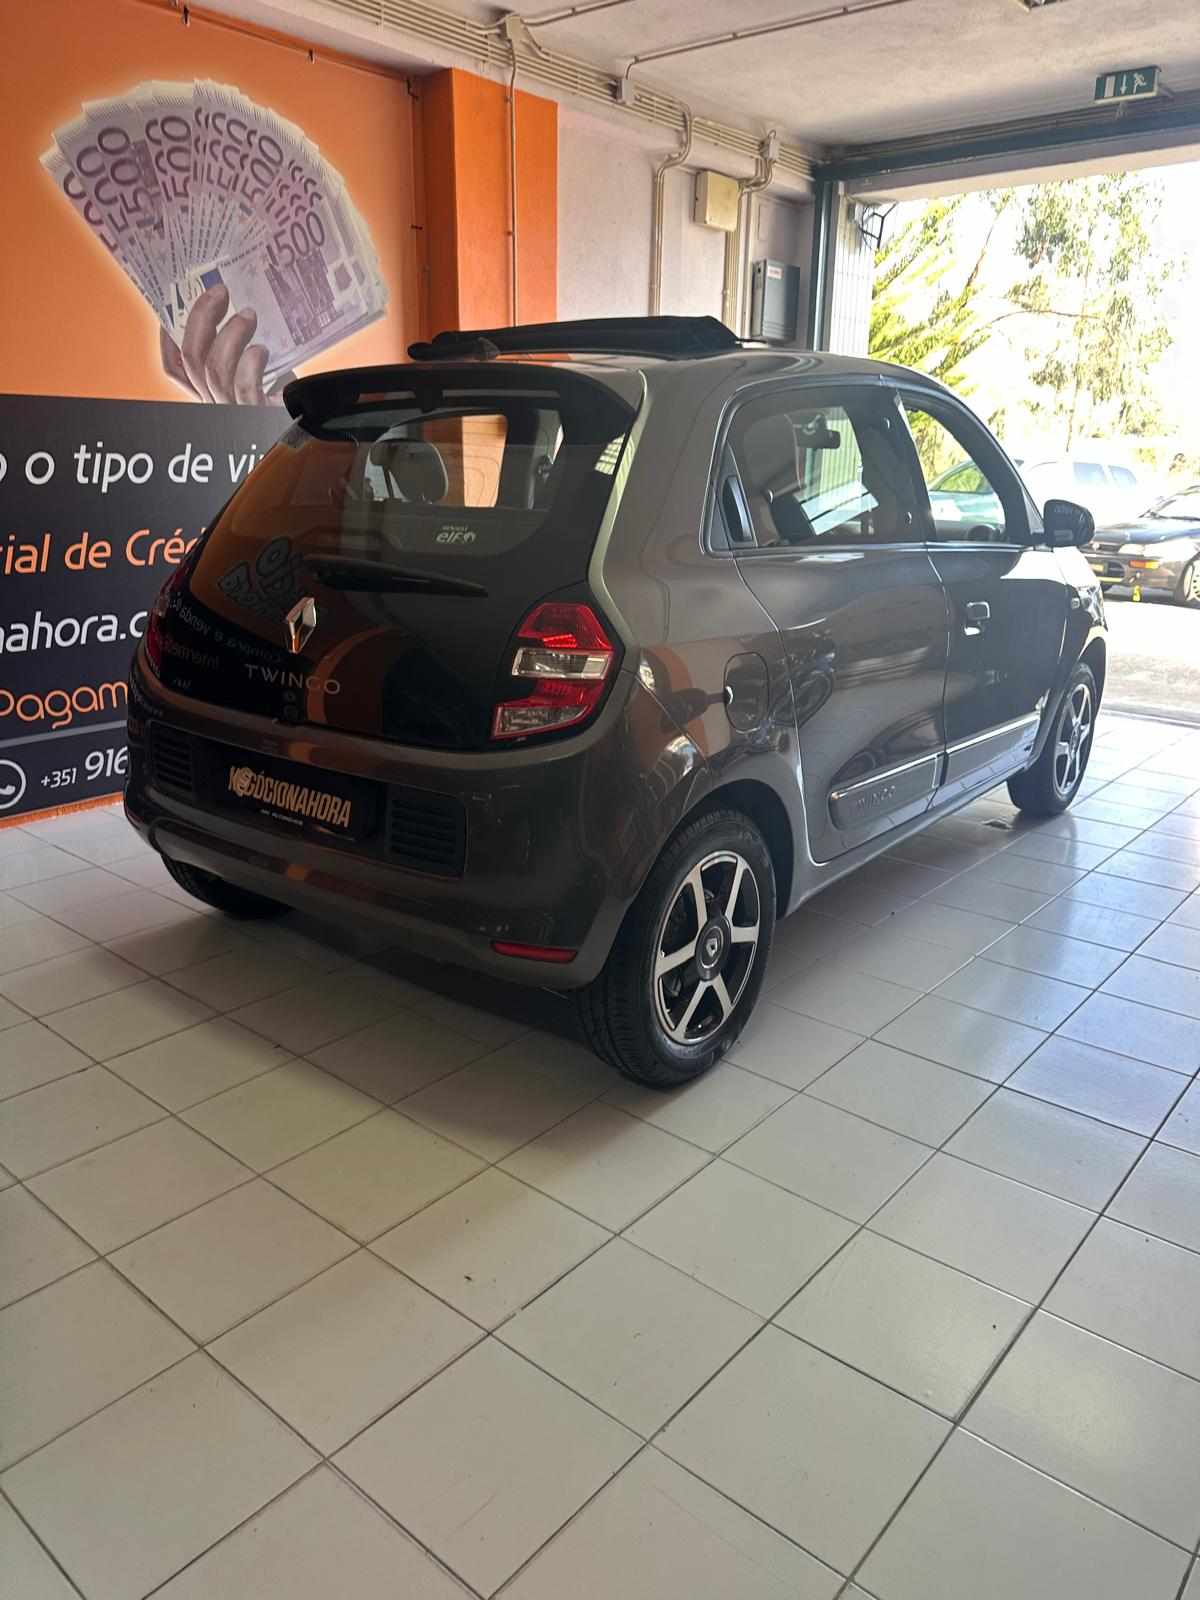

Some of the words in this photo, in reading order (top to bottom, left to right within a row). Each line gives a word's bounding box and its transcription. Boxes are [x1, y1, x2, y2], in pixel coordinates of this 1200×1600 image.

[273, 210, 325, 266] 500
[25, 451, 56, 485] o
[74, 441, 154, 493] tipo
[168, 442, 214, 484] de
[228, 443, 265, 483] vi
[0, 533, 51, 576] ial
[64, 531, 112, 570] de
[0, 610, 149, 655] ahora.c
[244, 663, 342, 697] TWINGO
[40, 767, 77, 789] +351
